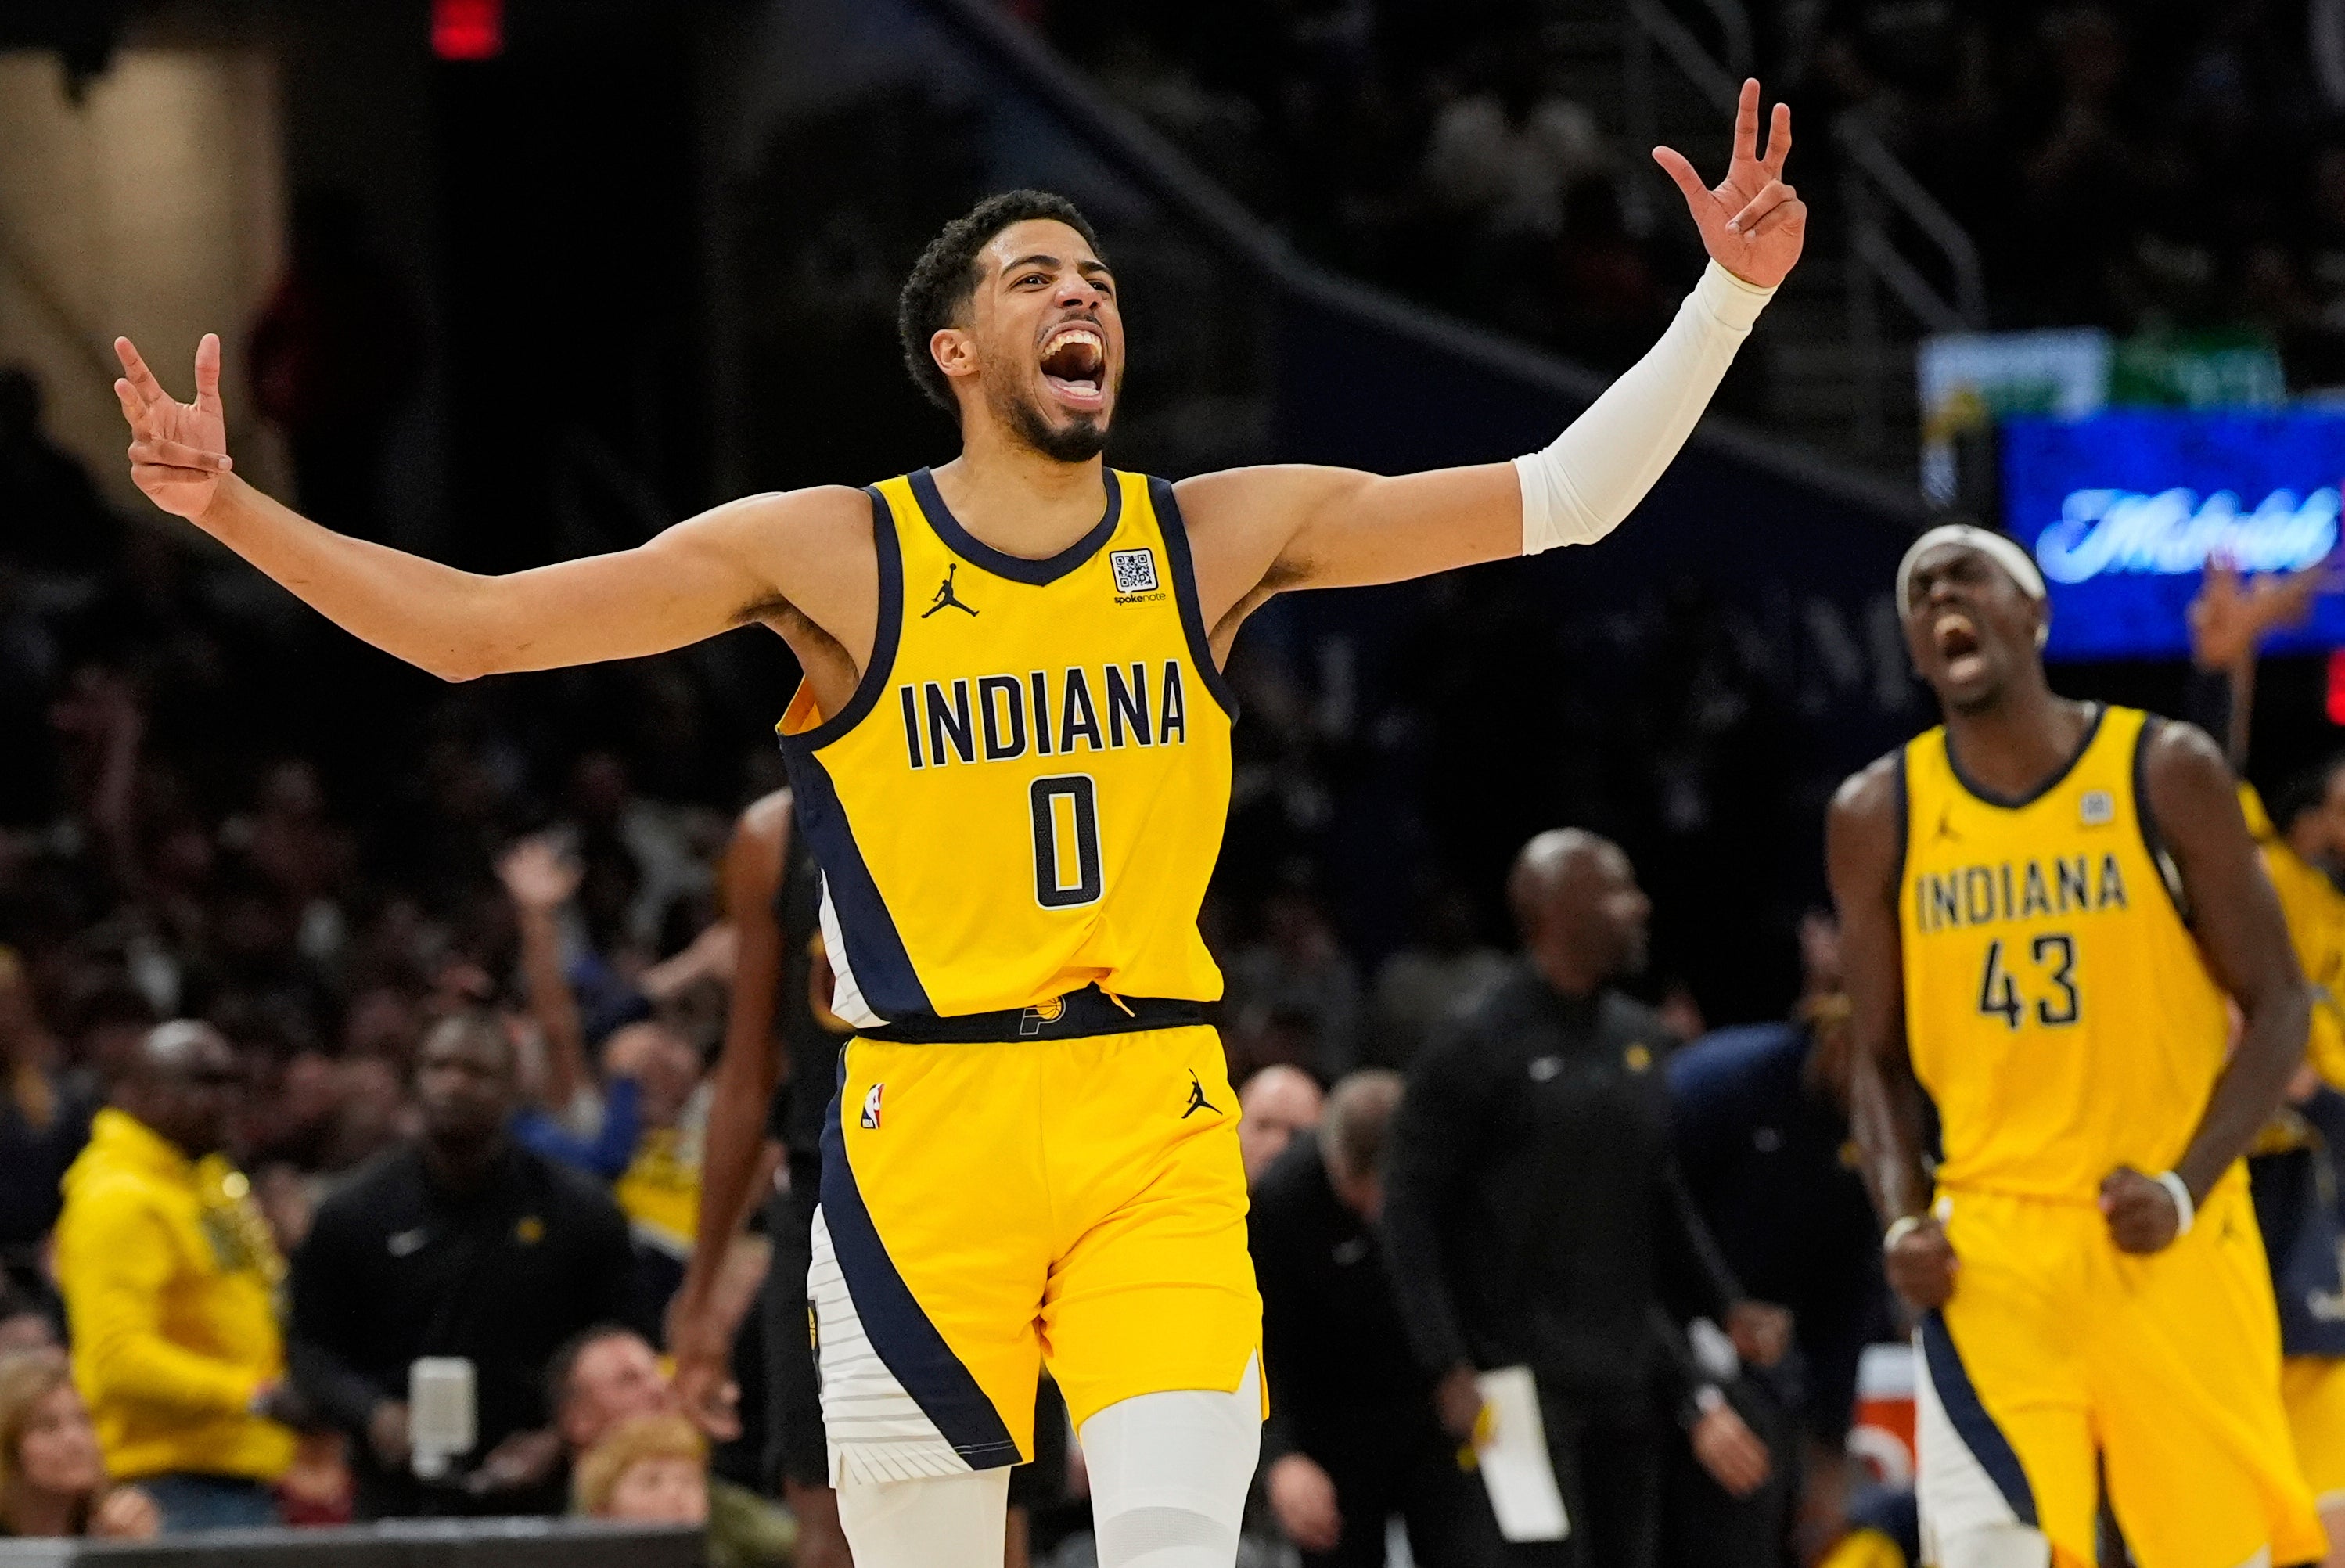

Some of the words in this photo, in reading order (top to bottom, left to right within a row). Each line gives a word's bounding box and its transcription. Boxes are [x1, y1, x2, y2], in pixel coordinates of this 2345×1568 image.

[1114, 593, 1166, 606] spokenote
[898, 658, 1188, 771] INDIANA
[1027, 771, 1105, 911] 0
[1915, 852, 2127, 933] INDIANA
[1978, 933, 2080, 1031] 43
